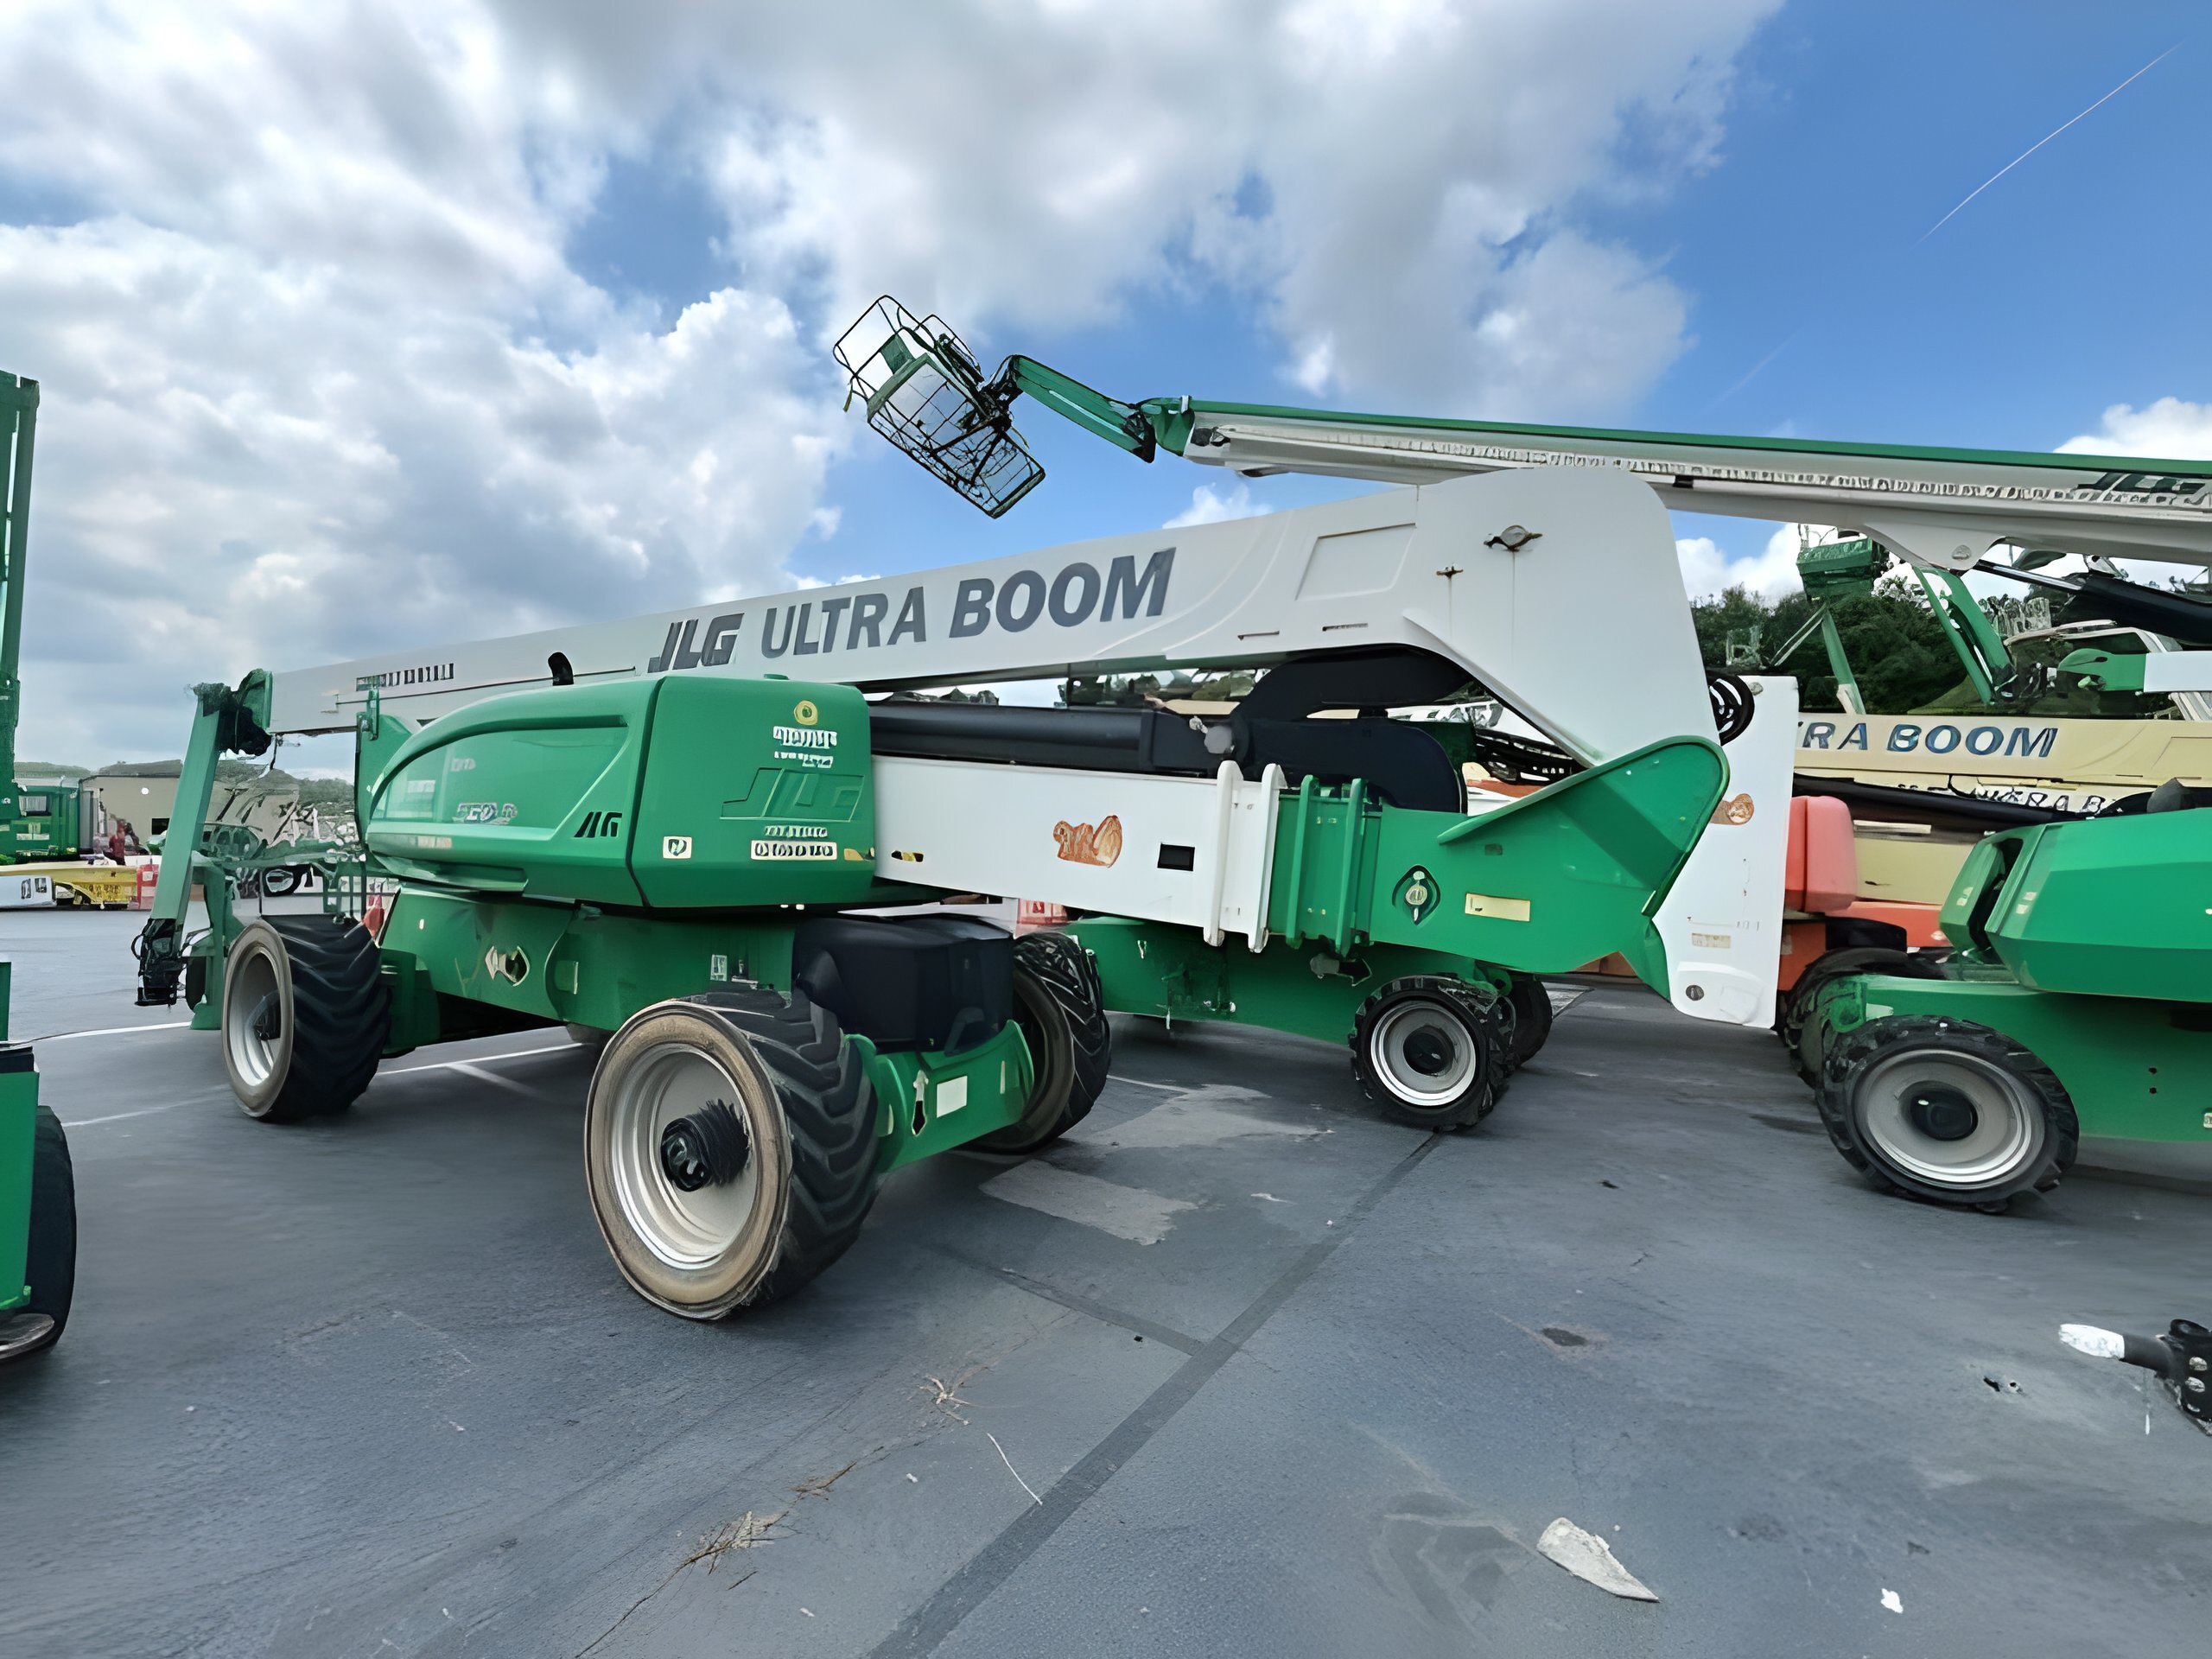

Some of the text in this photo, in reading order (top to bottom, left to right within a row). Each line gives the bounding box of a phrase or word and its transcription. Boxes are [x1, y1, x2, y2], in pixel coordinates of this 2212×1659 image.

[648, 547, 1177, 673] JLG ULTRA BOOM
[1886, 723, 2059, 759] BOOM
